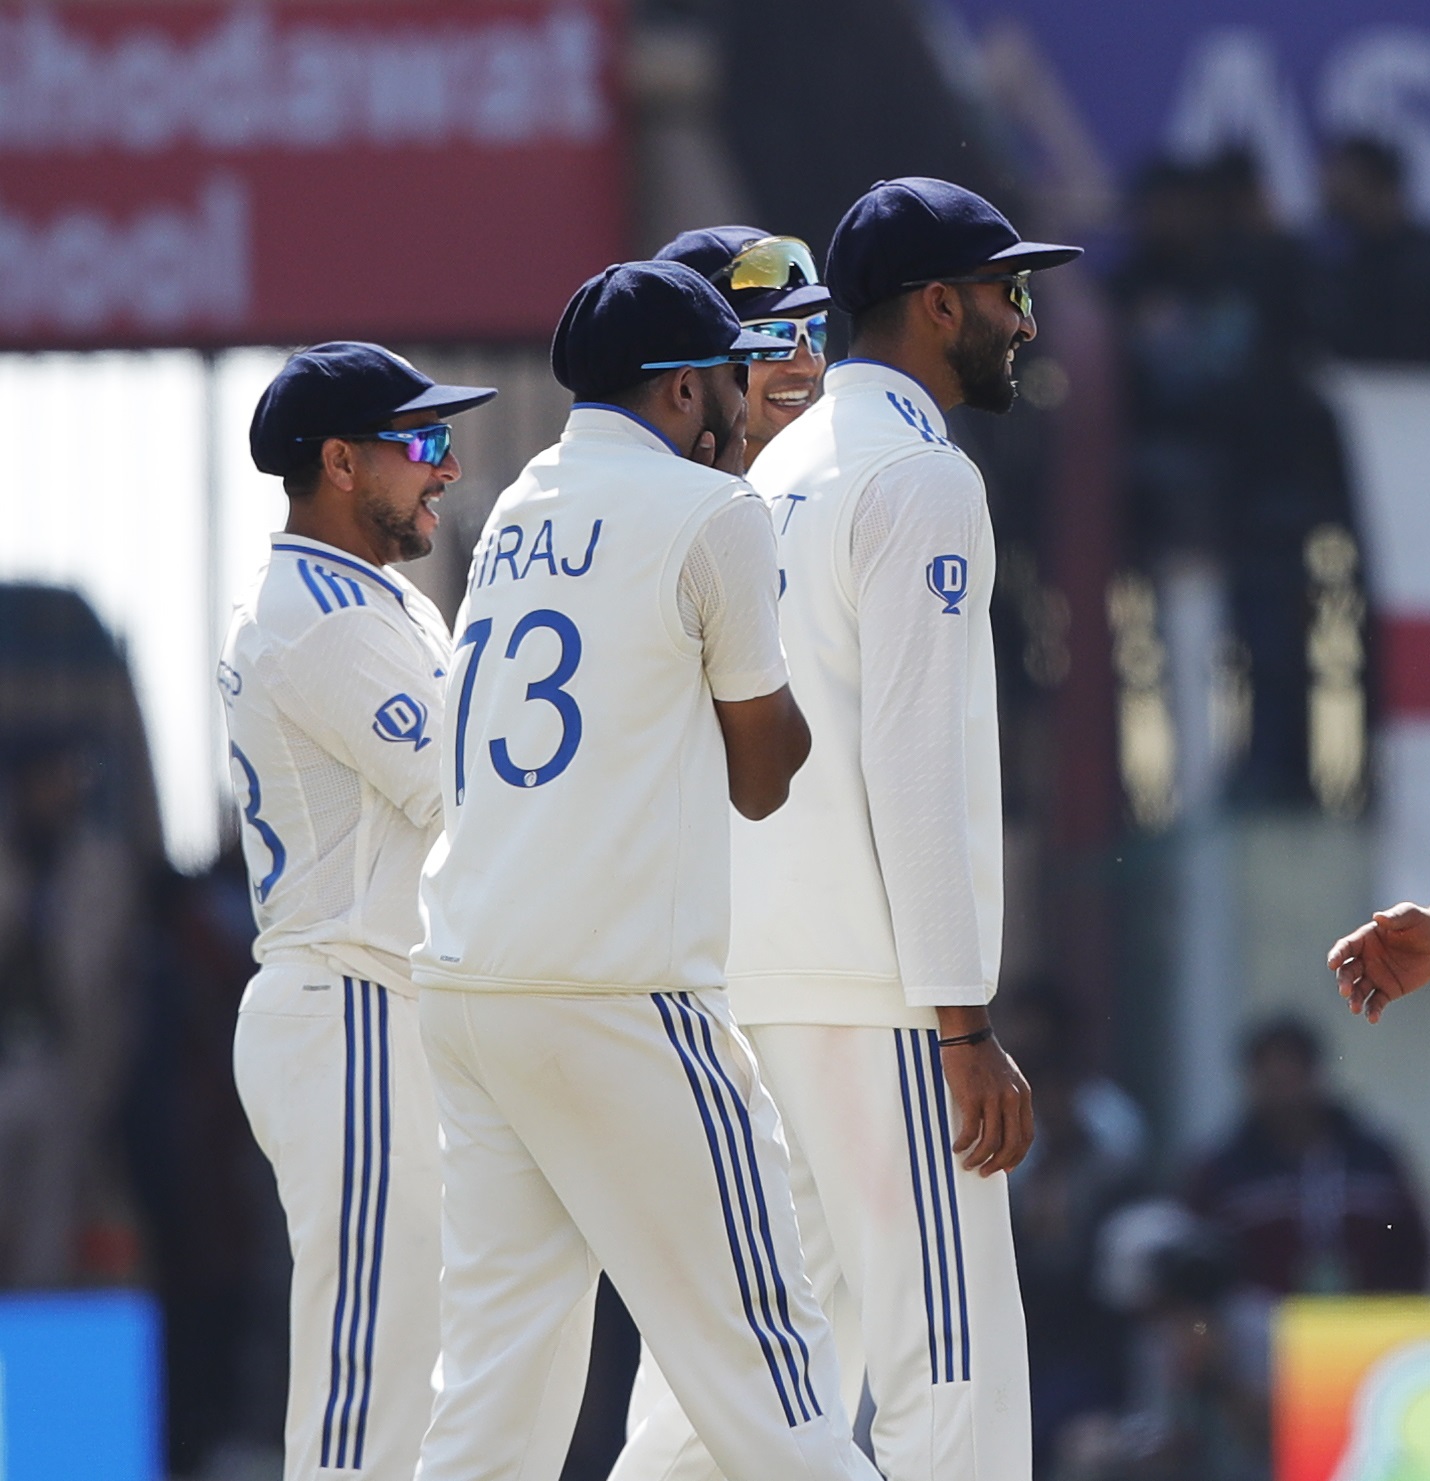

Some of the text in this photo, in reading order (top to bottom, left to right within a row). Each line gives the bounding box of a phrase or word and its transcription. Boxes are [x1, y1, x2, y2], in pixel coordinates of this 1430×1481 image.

[0, 3, 604, 152] hodawat
[469, 519, 603, 596] IRAJ
[453, 609, 583, 806] 73
